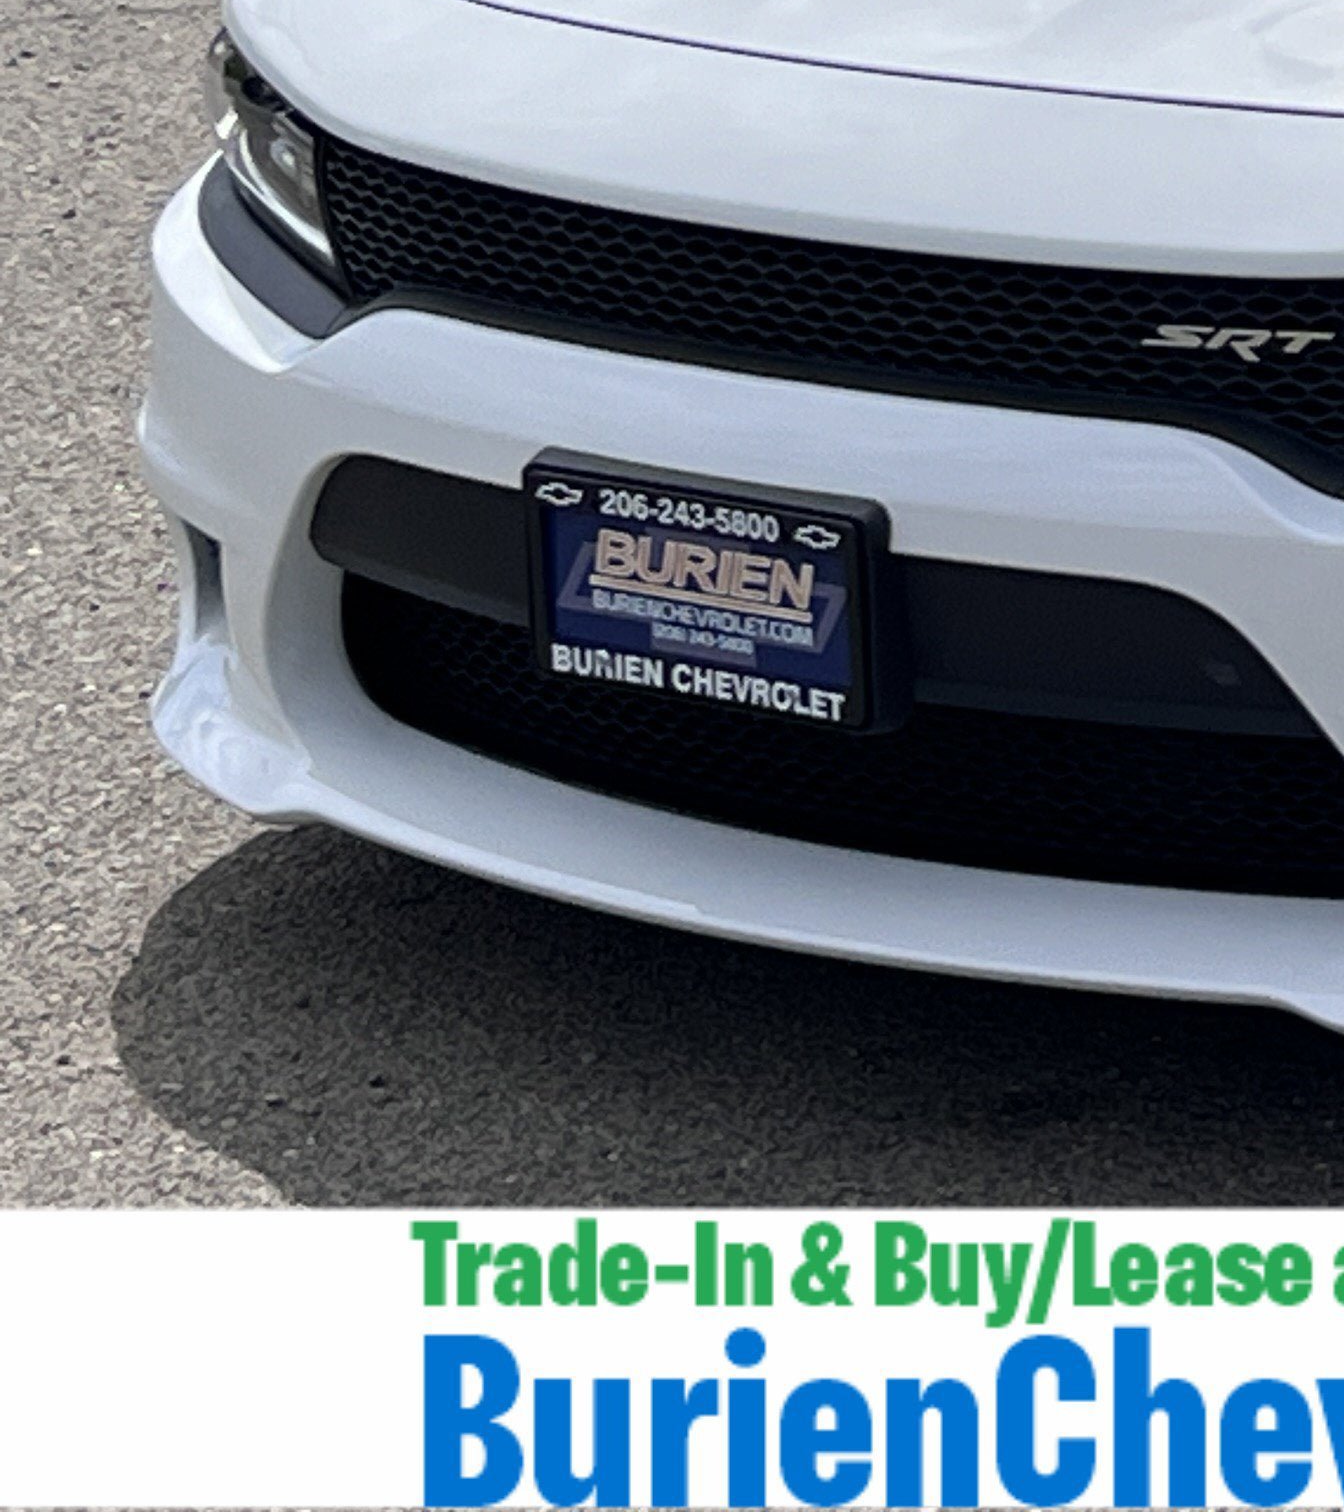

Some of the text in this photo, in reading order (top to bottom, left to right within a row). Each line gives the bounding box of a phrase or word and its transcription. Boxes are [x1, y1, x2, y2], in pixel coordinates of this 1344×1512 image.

[1140, 324, 1336, 363] SRT
[599, 488, 780, 542] 206-243-5800
[594, 528, 815, 610] BURIEN
[593, 589, 814, 646] BURIENCHEVROLET.COM
[550, 642, 846, 722] BURIEN CHEVROLET
